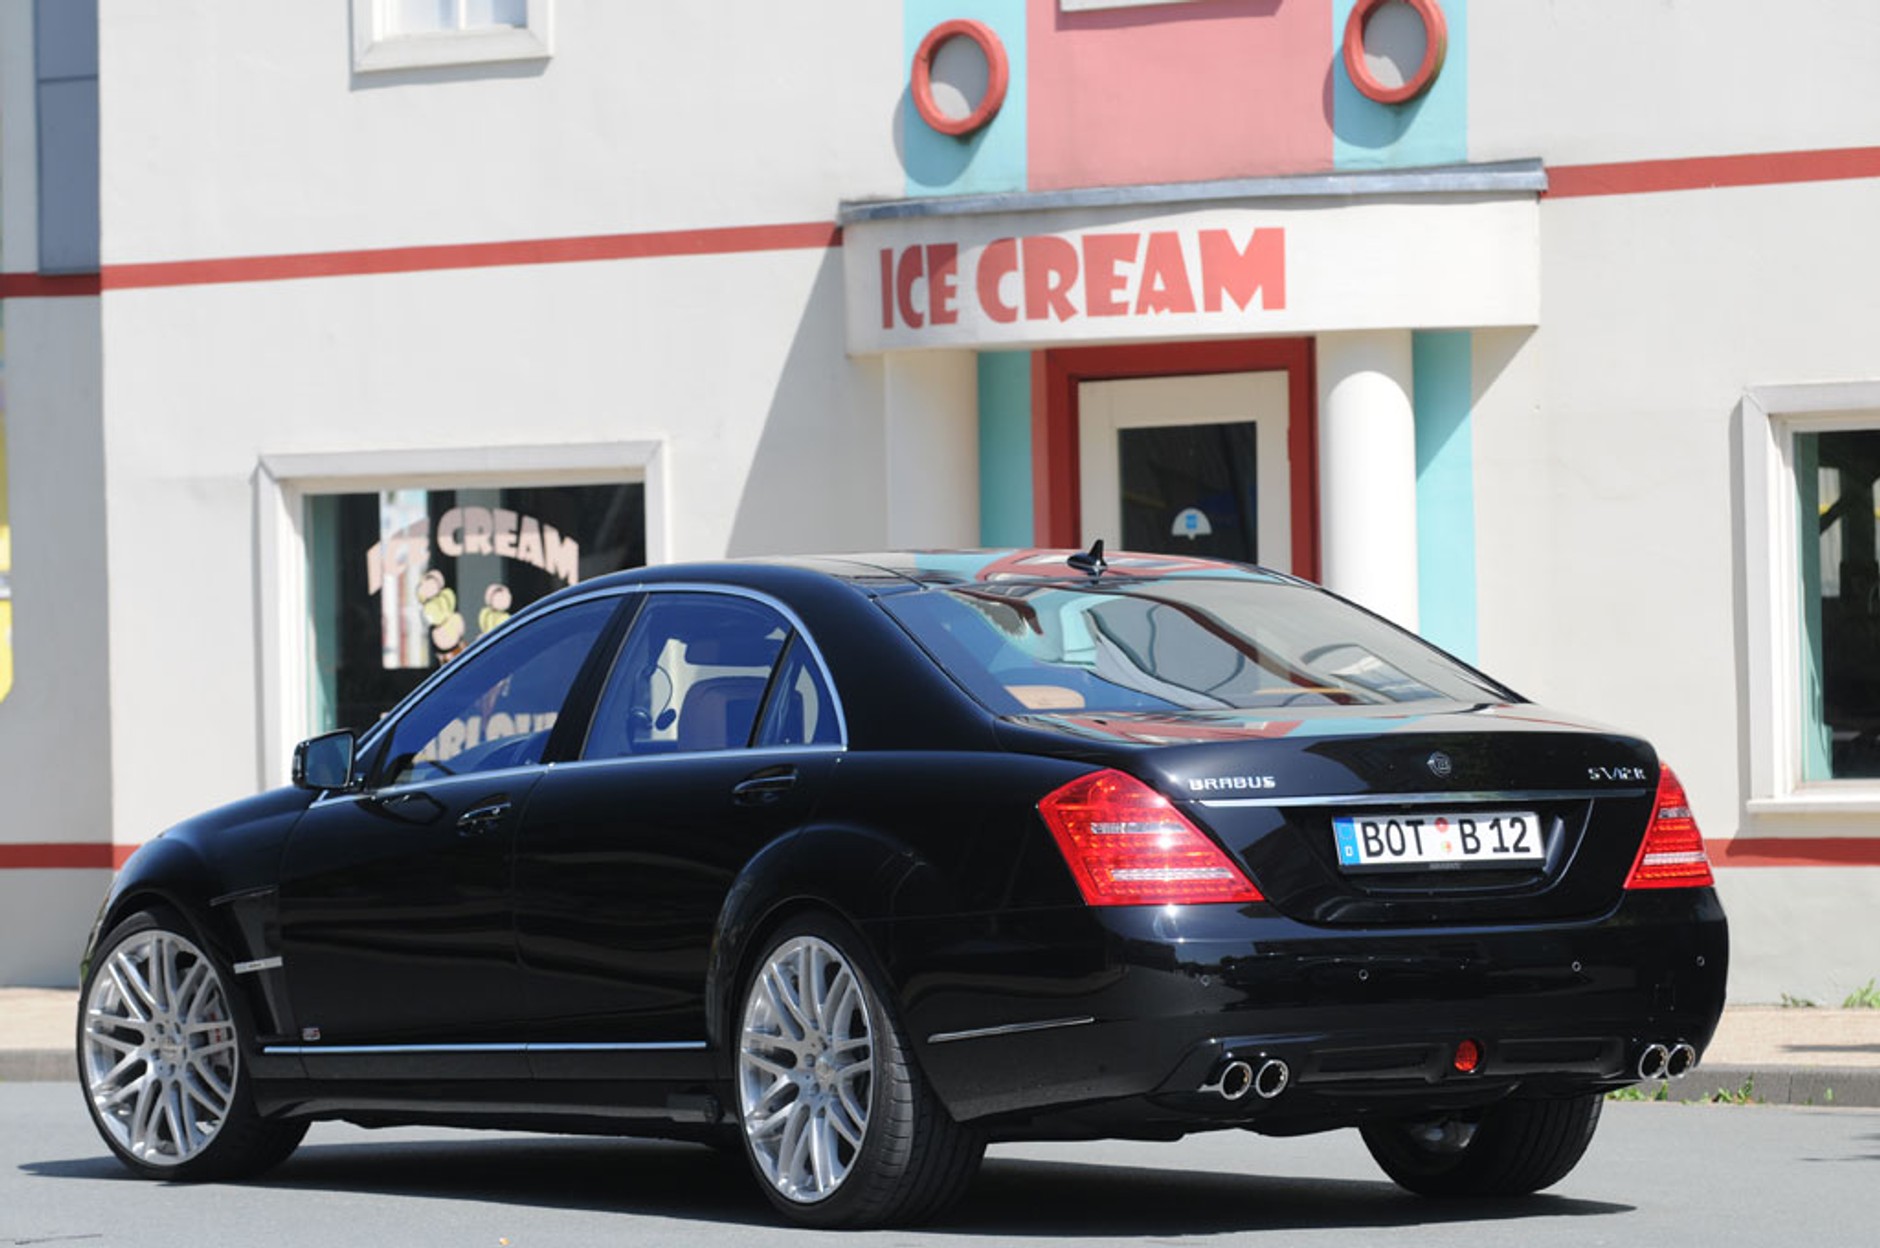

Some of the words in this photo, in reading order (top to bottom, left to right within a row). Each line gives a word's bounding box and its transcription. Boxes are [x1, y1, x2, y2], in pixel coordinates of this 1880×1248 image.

[880, 243, 959, 329] ICE
[976, 227, 1286, 323] CREAM
[437, 505, 580, 587] CREAM
[1189, 776, 1276, 791] BRABUS
[1361, 819, 1425, 858] BOT
[1459, 819, 1482, 855] B
[1489, 816, 1531, 853] 12
